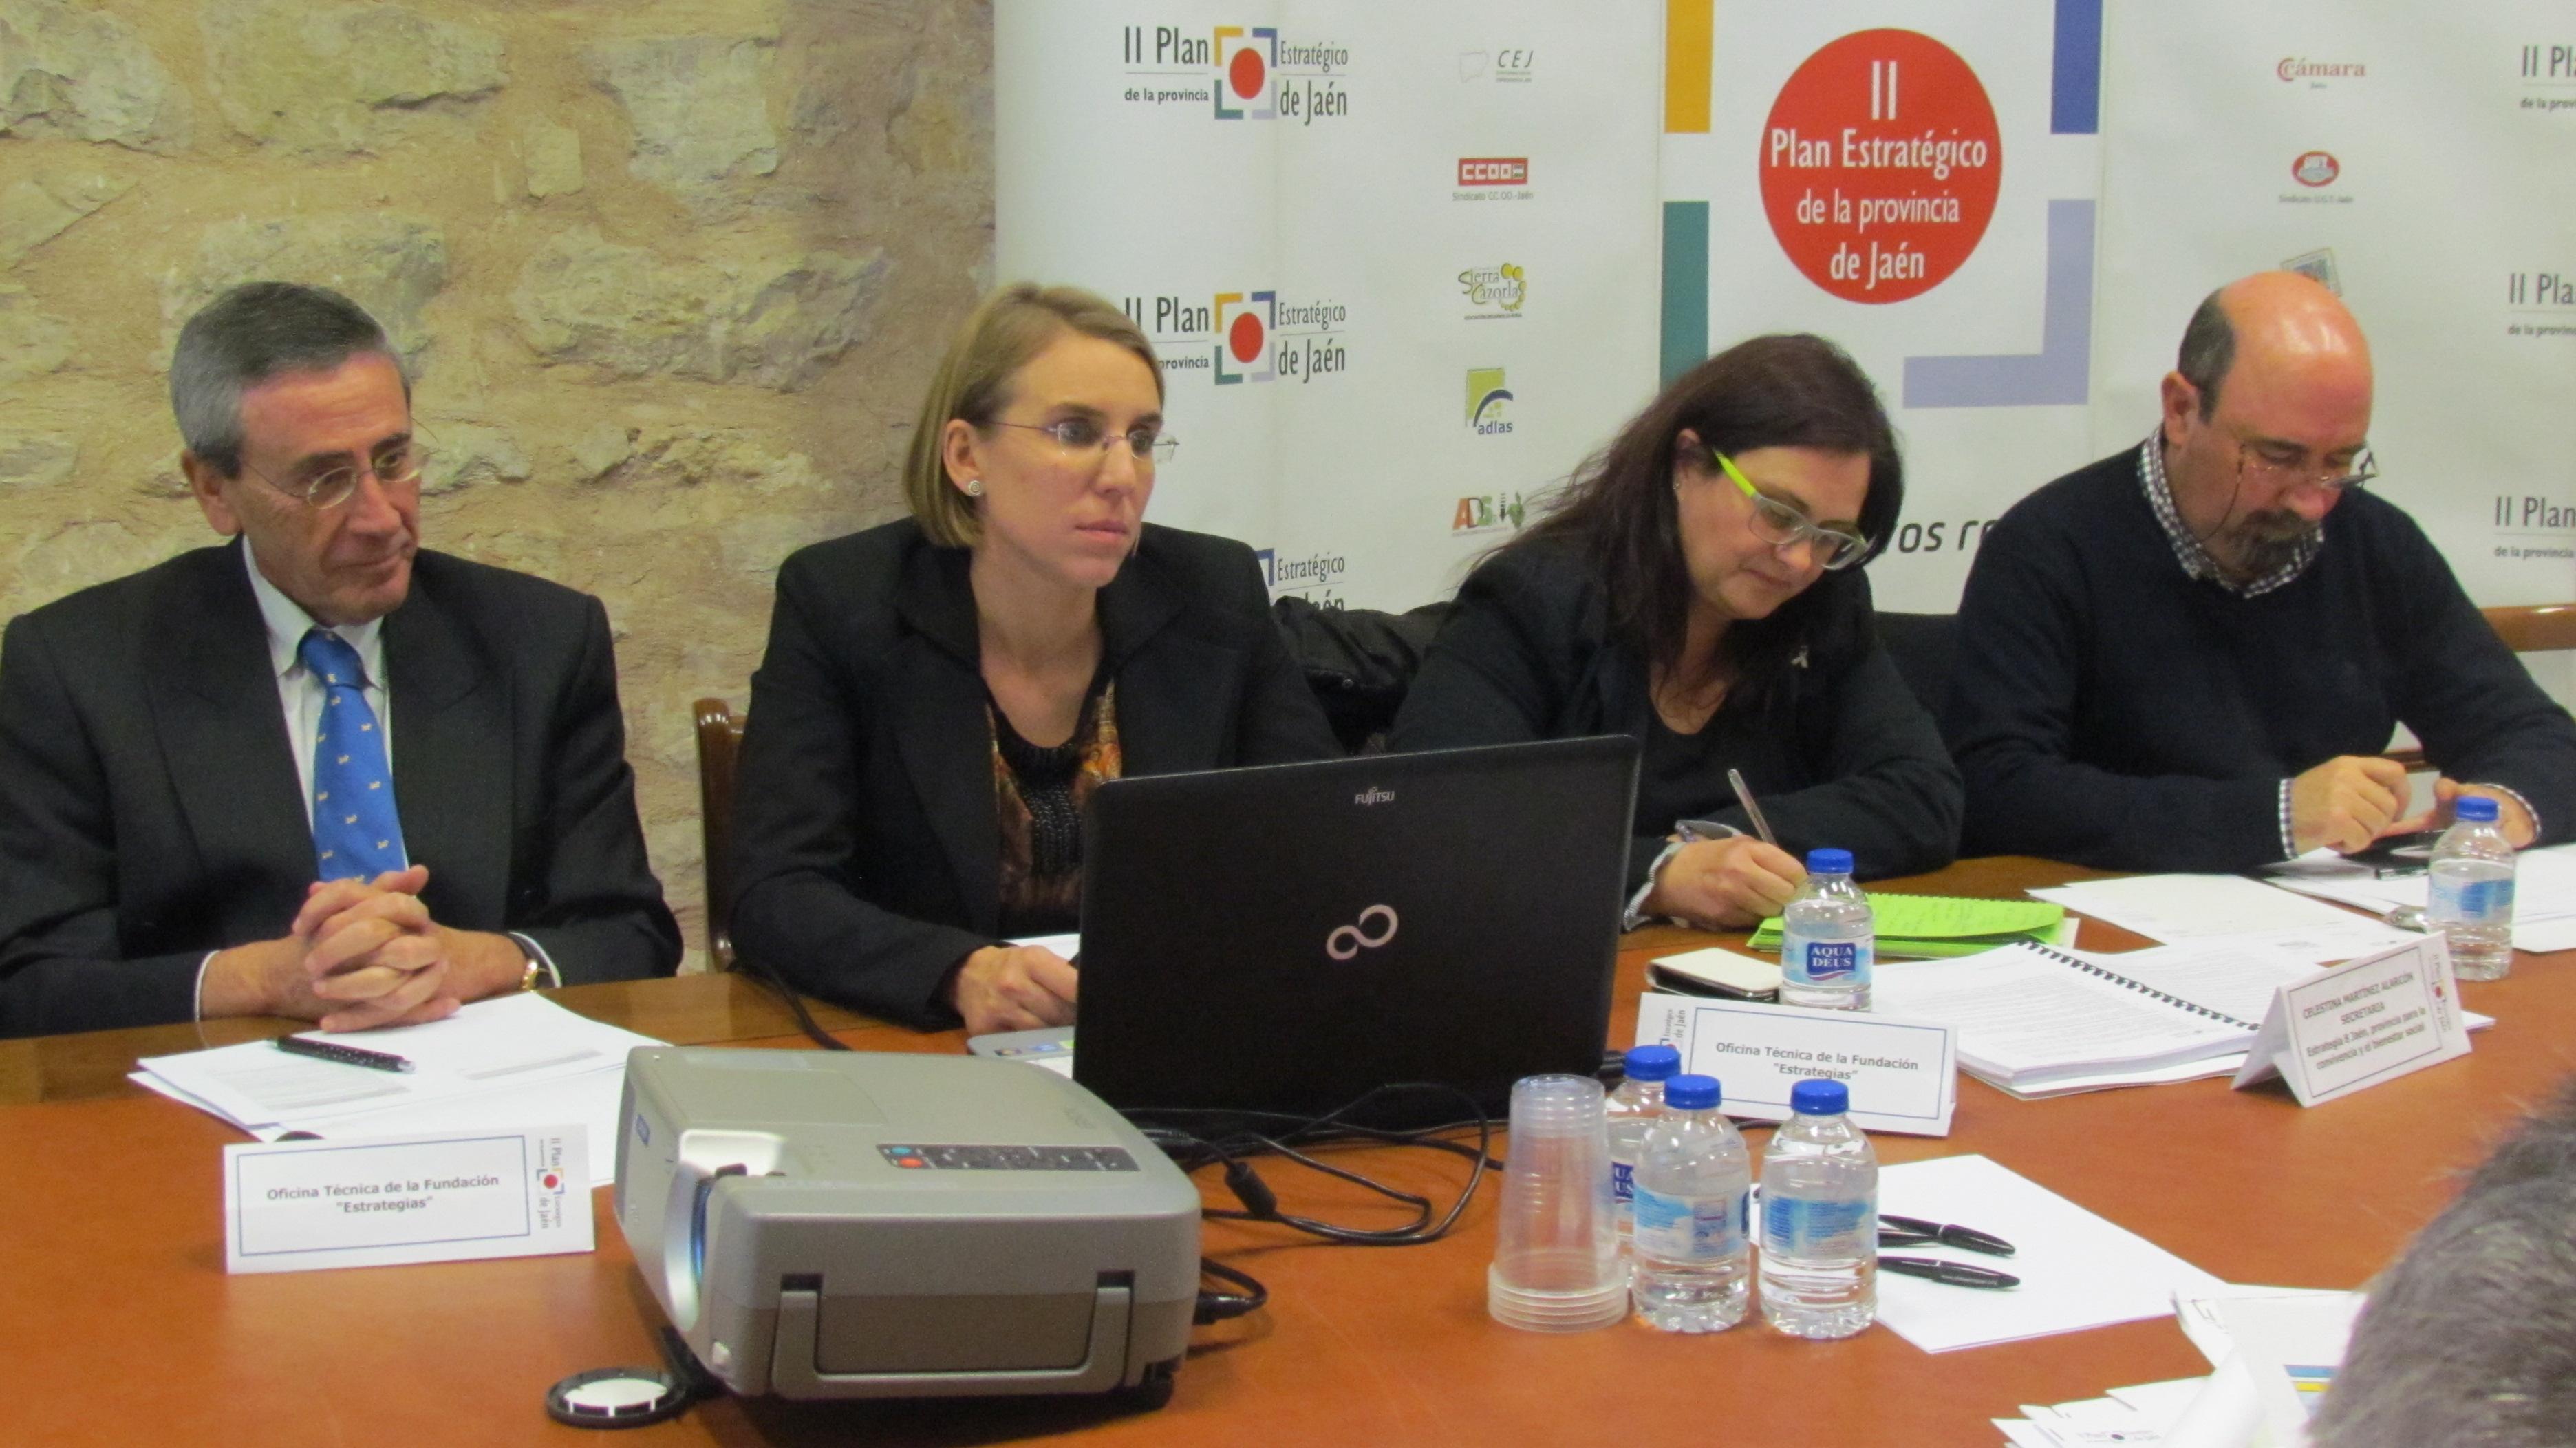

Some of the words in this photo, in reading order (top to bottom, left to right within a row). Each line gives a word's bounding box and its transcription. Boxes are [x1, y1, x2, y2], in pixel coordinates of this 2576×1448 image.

[1125, 26, 1141, 64] II
[1157, 26, 1208, 64] Plan
[1280, 40, 1348, 73] Estratégico
[2522, 45, 2537, 77] II
[2549, 45, 2576, 77] Pl
[1125, 87, 1140, 101] de
[1144, 87, 1155, 101] la
[1157, 88, 1209, 105] provincia
[1280, 80, 1300, 116] de
[1304, 79, 1347, 125] Jaén
[1871, 61, 1898, 121] II
[1771, 129, 1831, 167] Plan
[1842, 129, 1988, 181] Estratégico
[1797, 188, 1825, 224] de
[1834, 188, 1851, 224] la
[1860, 189, 1960, 234] provincia
[1830, 242, 1860, 280] de
[1865, 242, 1924, 290] Jaén
[2509, 273, 2525, 304] II
[1157, 296, 1209, 333] Plan
[1279, 299, 1346, 330] Estratégico
[1279, 340, 1298, 376] de
[1303, 338, 1345, 383] Jaén
[1478, 420, 1513, 435] adlas
[2495, 496, 2511, 526] II
[2523, 496, 2576, 528] Plan
[1278, 551, 1344, 582] Estratégico
[1355, 790, 1395, 806] FUJITSU
[1811, 946, 1853, 957] AQUA
[1812, 957, 1852, 967] DEUS
[1716, 1042, 1761, 1056] Oficina
[1765, 1047, 1812, 1061] Técnica
[1816, 1052, 1832, 1063] de
[1836, 1053, 1847, 1064] la
[1852, 1055, 1919, 1069] Fundación
[267, 1189, 319, 1200] Oficina
[324, 1183, 380, 1197] Técnica
[385, 1181, 402, 1193] de
[407, 1180, 420, 1191] la
[424, 1175, 500, 1190] Fundación
